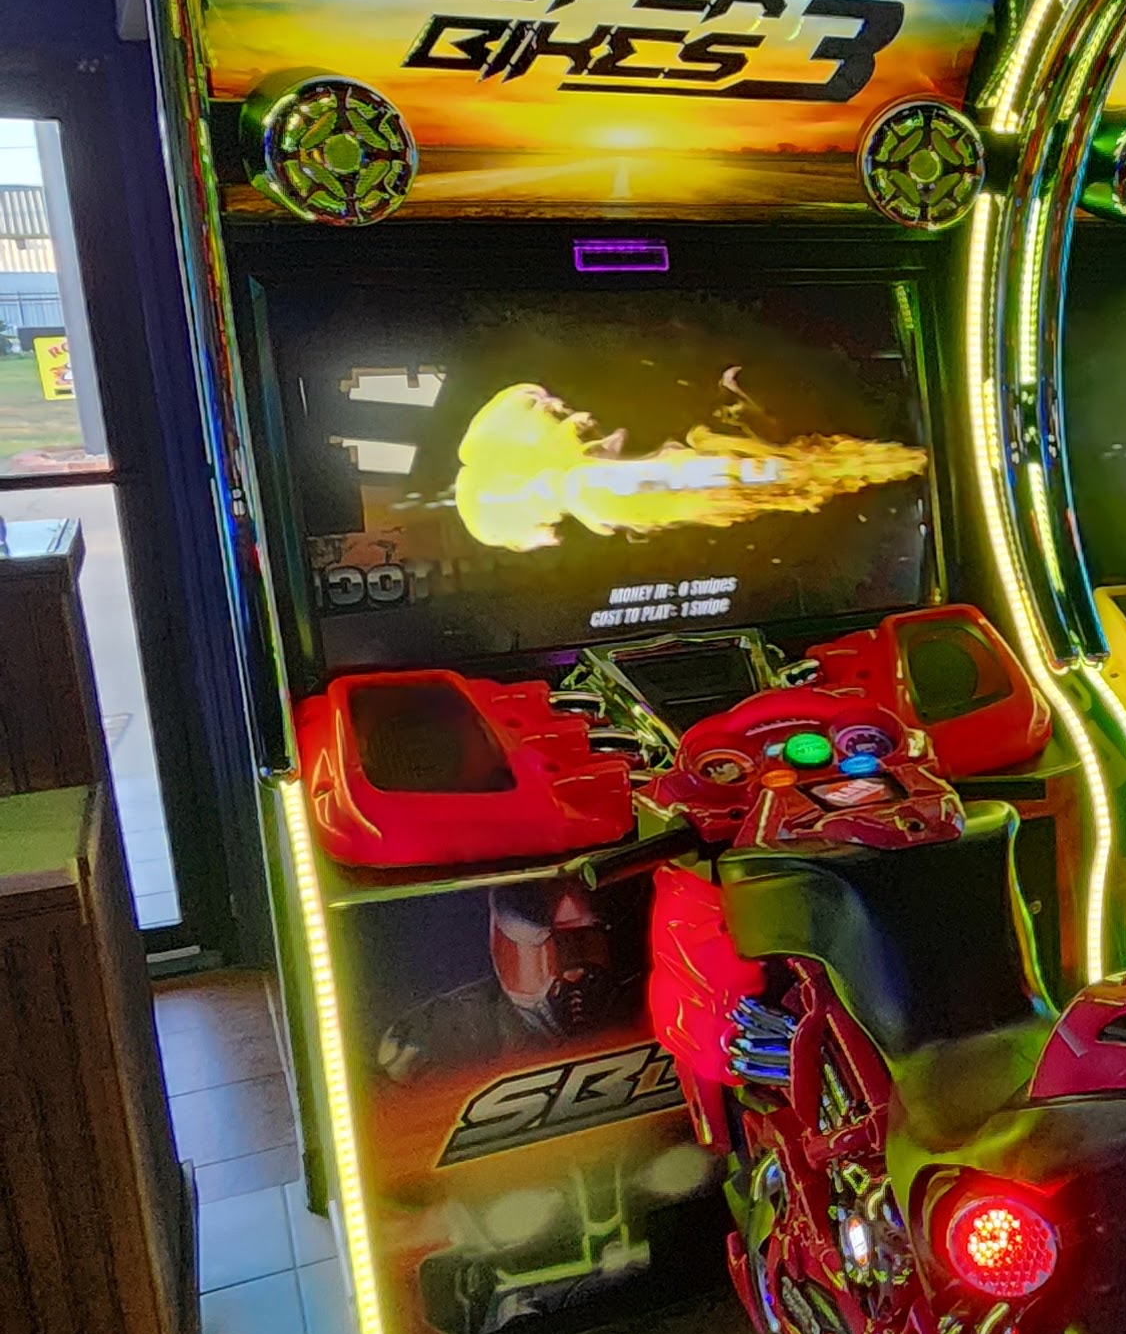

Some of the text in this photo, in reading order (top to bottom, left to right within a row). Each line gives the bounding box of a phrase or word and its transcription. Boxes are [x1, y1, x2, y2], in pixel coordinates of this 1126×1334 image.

[400, 13, 767, 84] BIKES
[609, 584, 655, 605] MONEY
[677, 581, 690, 598] 0
[589, 608, 623, 628] COST
[622, 607, 640, 624] TO
[680, 601, 689, 617] 1
